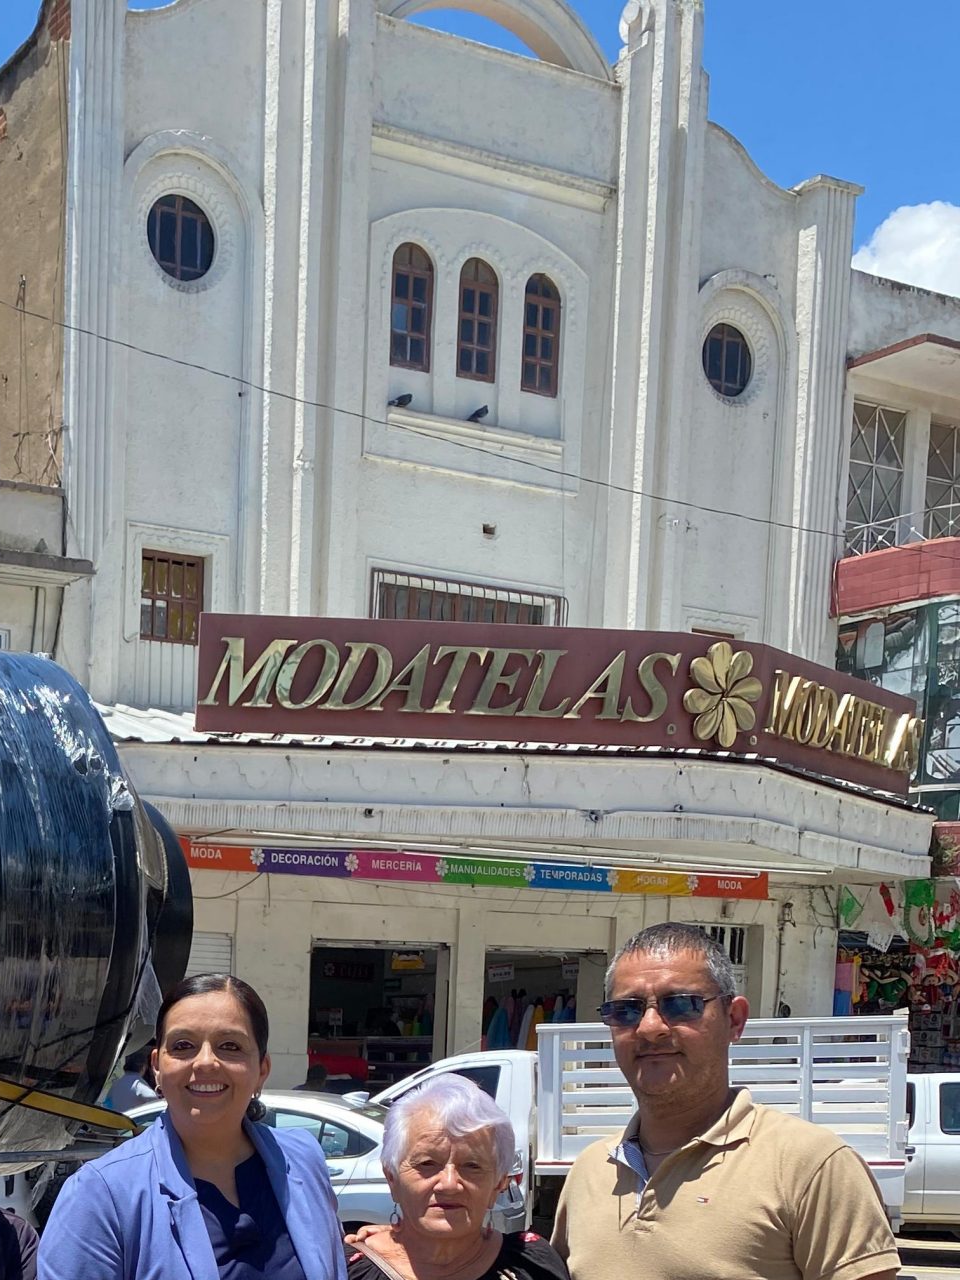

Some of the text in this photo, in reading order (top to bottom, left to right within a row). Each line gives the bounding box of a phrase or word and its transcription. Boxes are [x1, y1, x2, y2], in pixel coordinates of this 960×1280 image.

[197, 636, 682, 724] MODATELAS
[764, 669, 925, 773] MODATELAS
[190, 846, 223, 860] MODA
[270, 852, 339, 867] DECORACIÓN
[371, 858, 423, 872] MERCERÍA
[449, 862, 522, 878] MANUALIDADES
[539, 868, 603, 883] TEMPORADAS
[636, 875, 669, 887] HOGAR
[717, 879, 743, 891] MODA
